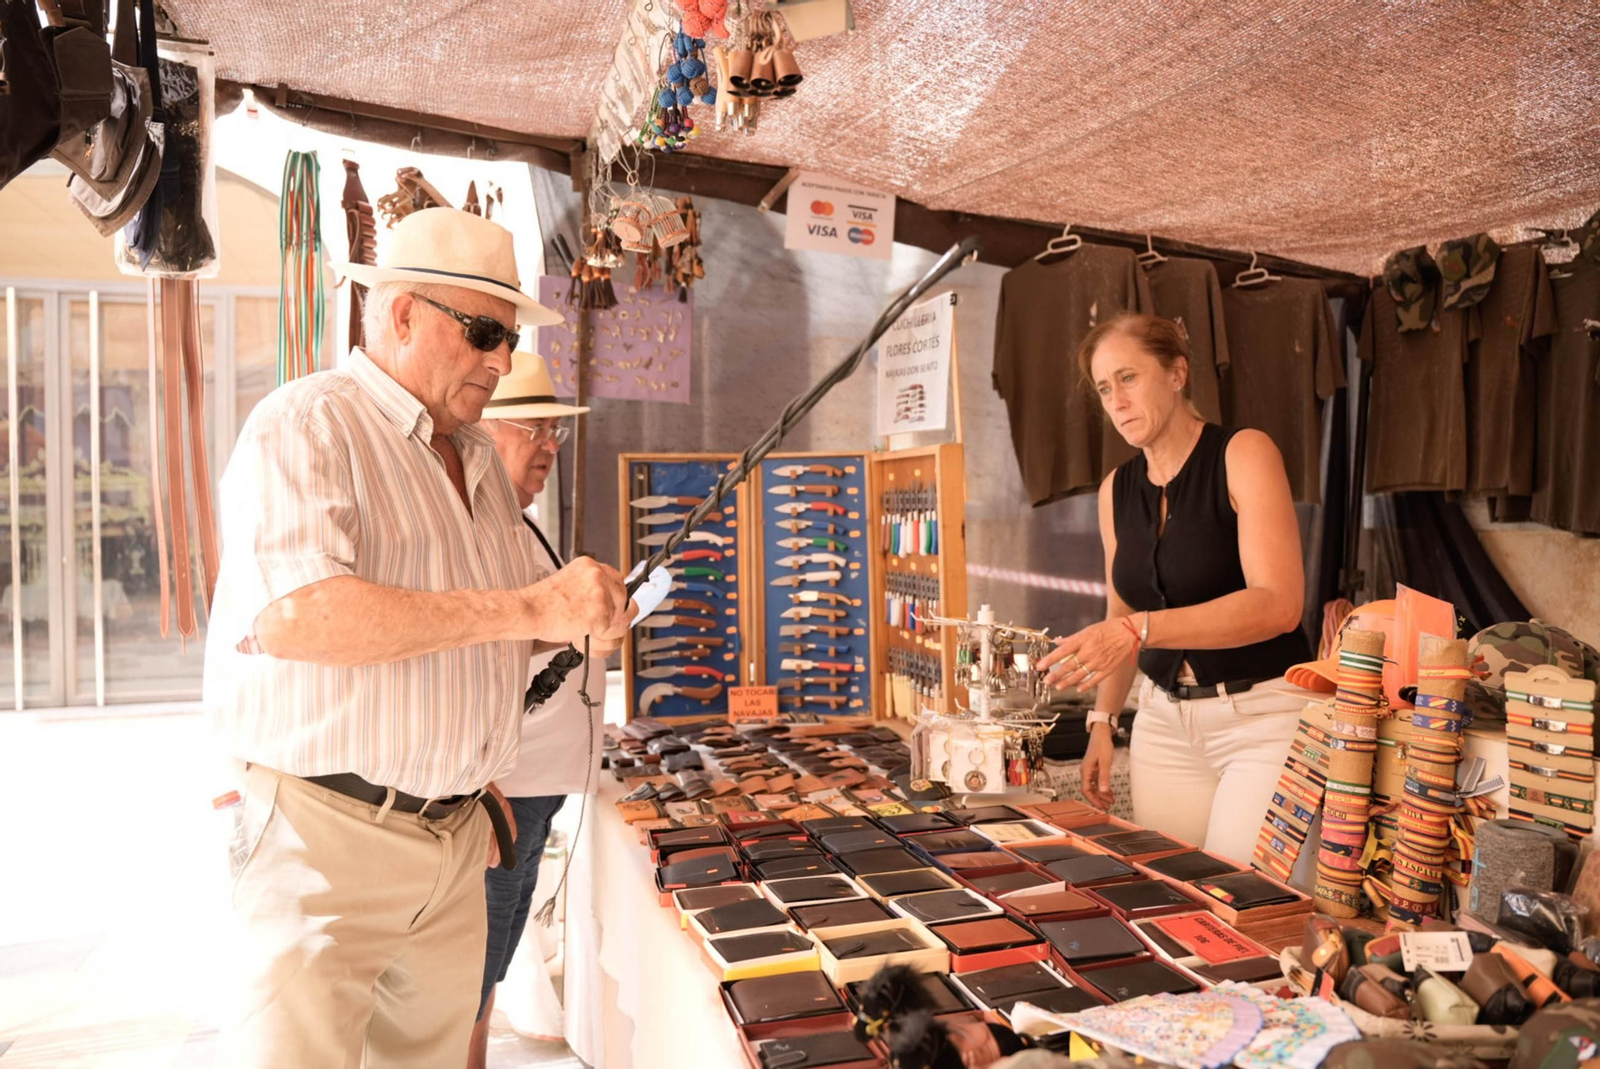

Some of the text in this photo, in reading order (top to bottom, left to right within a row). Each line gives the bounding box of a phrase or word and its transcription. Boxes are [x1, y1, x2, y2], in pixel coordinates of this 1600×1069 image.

[852, 210, 873, 220] VISA
[807, 223, 838, 238] VISA
[886, 342, 911, 357] FLORES
[1223, 937, 1237, 945] DE
